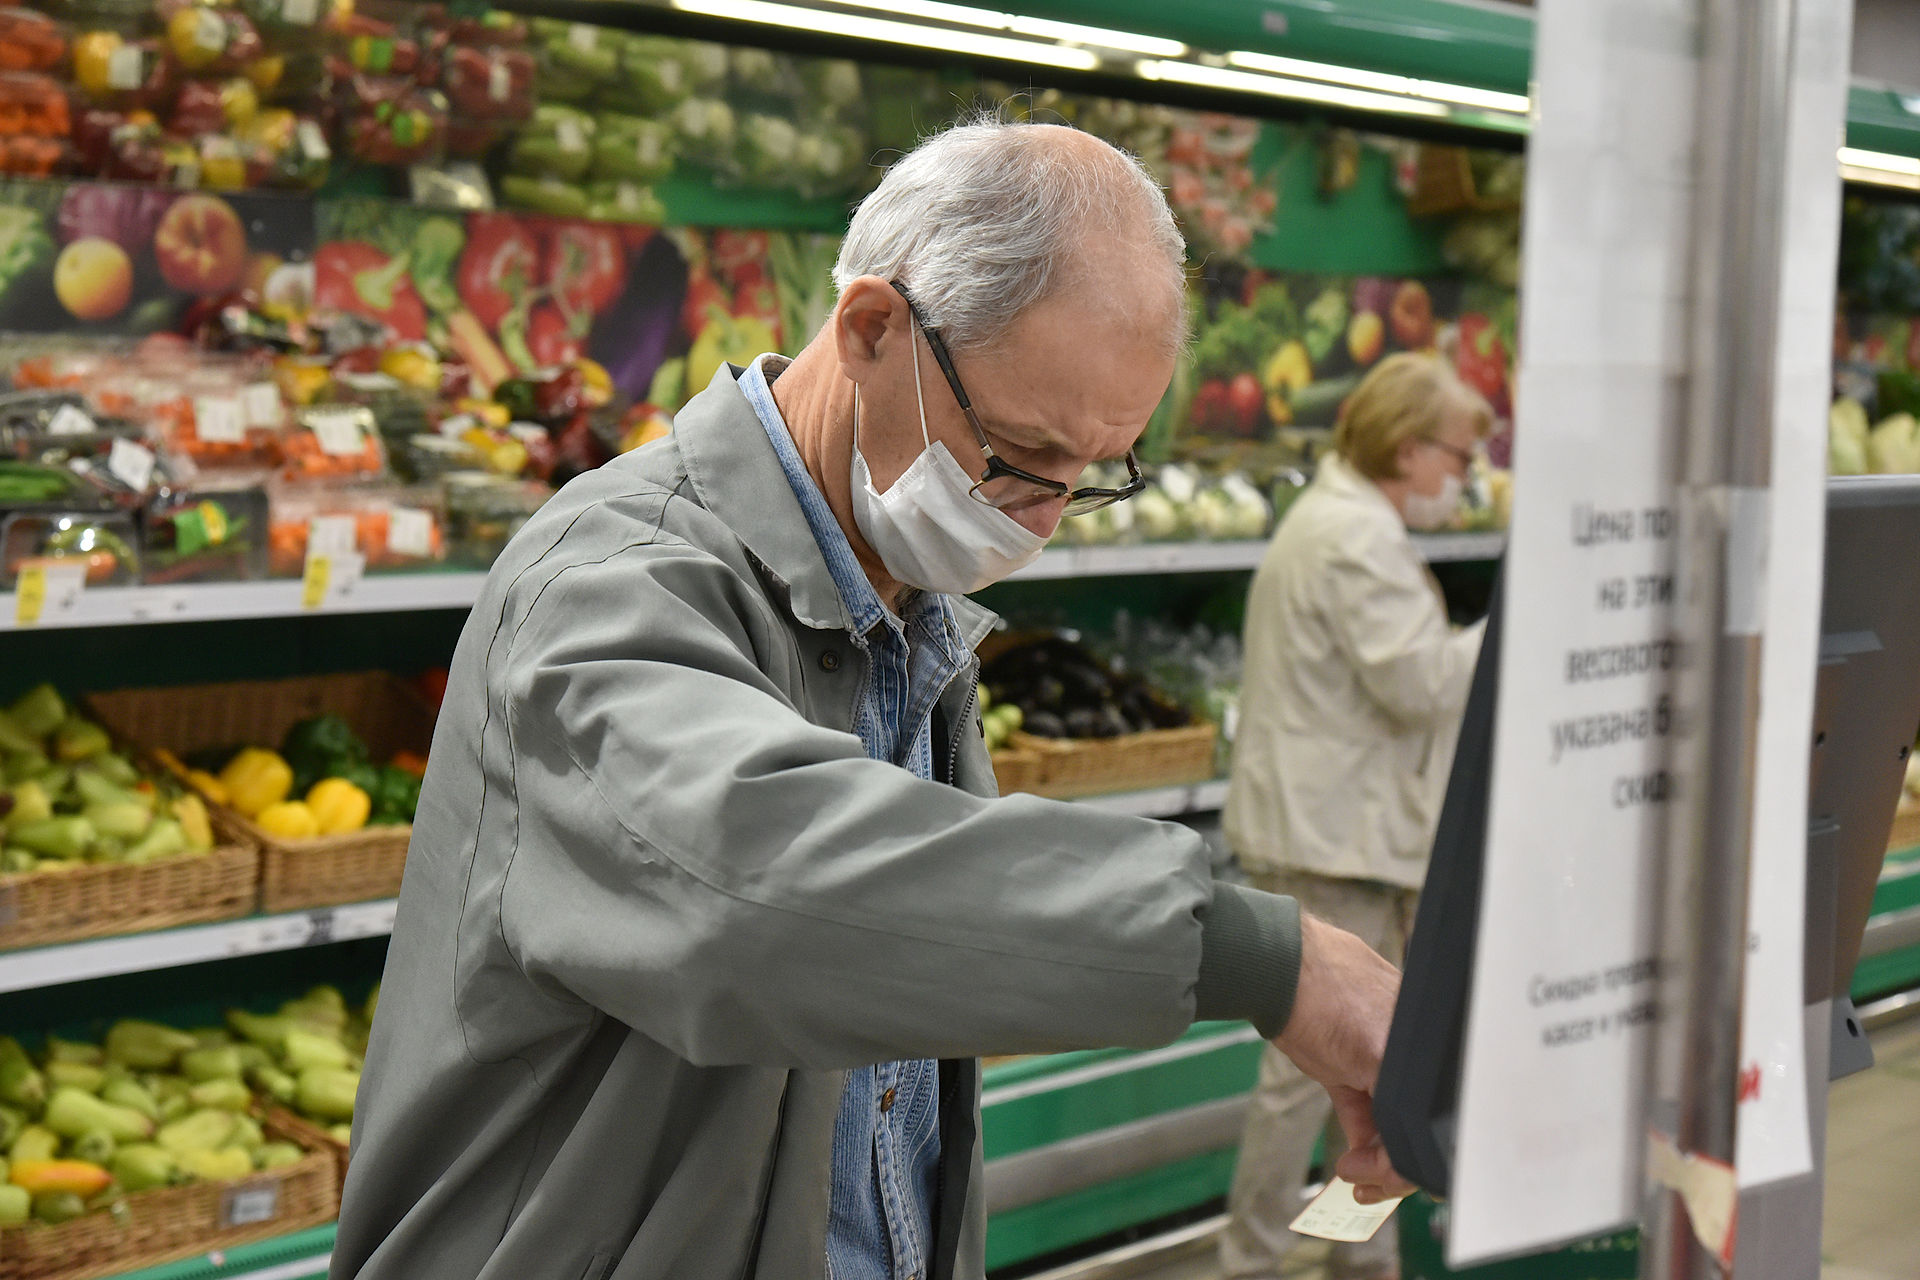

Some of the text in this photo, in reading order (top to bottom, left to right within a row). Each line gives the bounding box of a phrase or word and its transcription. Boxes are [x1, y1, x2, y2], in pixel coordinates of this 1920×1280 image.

[1571, 503, 1675, 547] Цена по
[1598, 574, 1674, 611] на эти
[1550, 707, 1650, 766] указана
